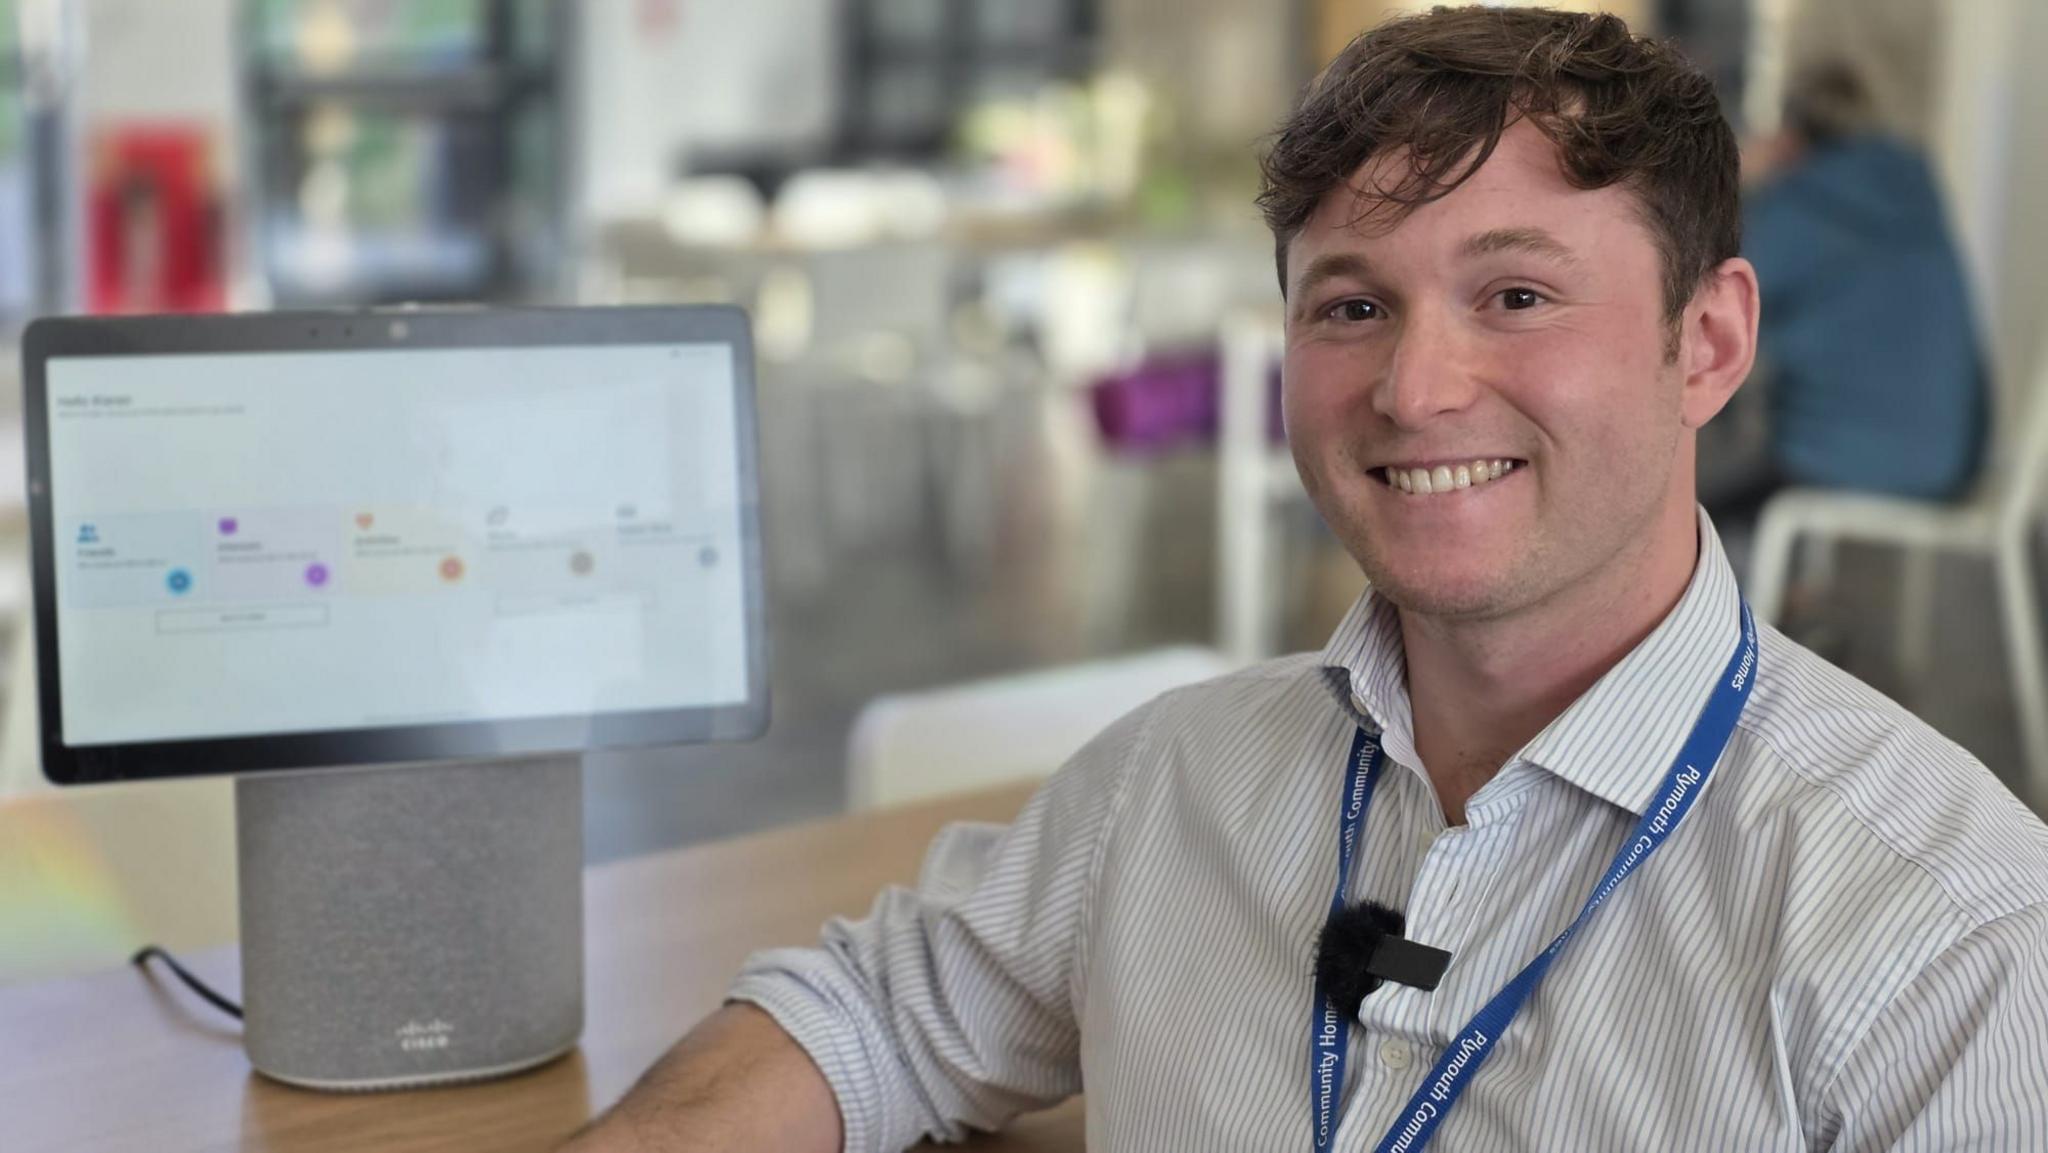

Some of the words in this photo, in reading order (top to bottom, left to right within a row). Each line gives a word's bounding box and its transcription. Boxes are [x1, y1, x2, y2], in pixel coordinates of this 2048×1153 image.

[1732, 646, 1756, 692] Homes
[1346, 741, 1380, 820] Community
[1648, 764, 1701, 834] Plymouth
[1317, 1052, 1339, 1147] Community
[1429, 1029, 1488, 1101] Plymouth
